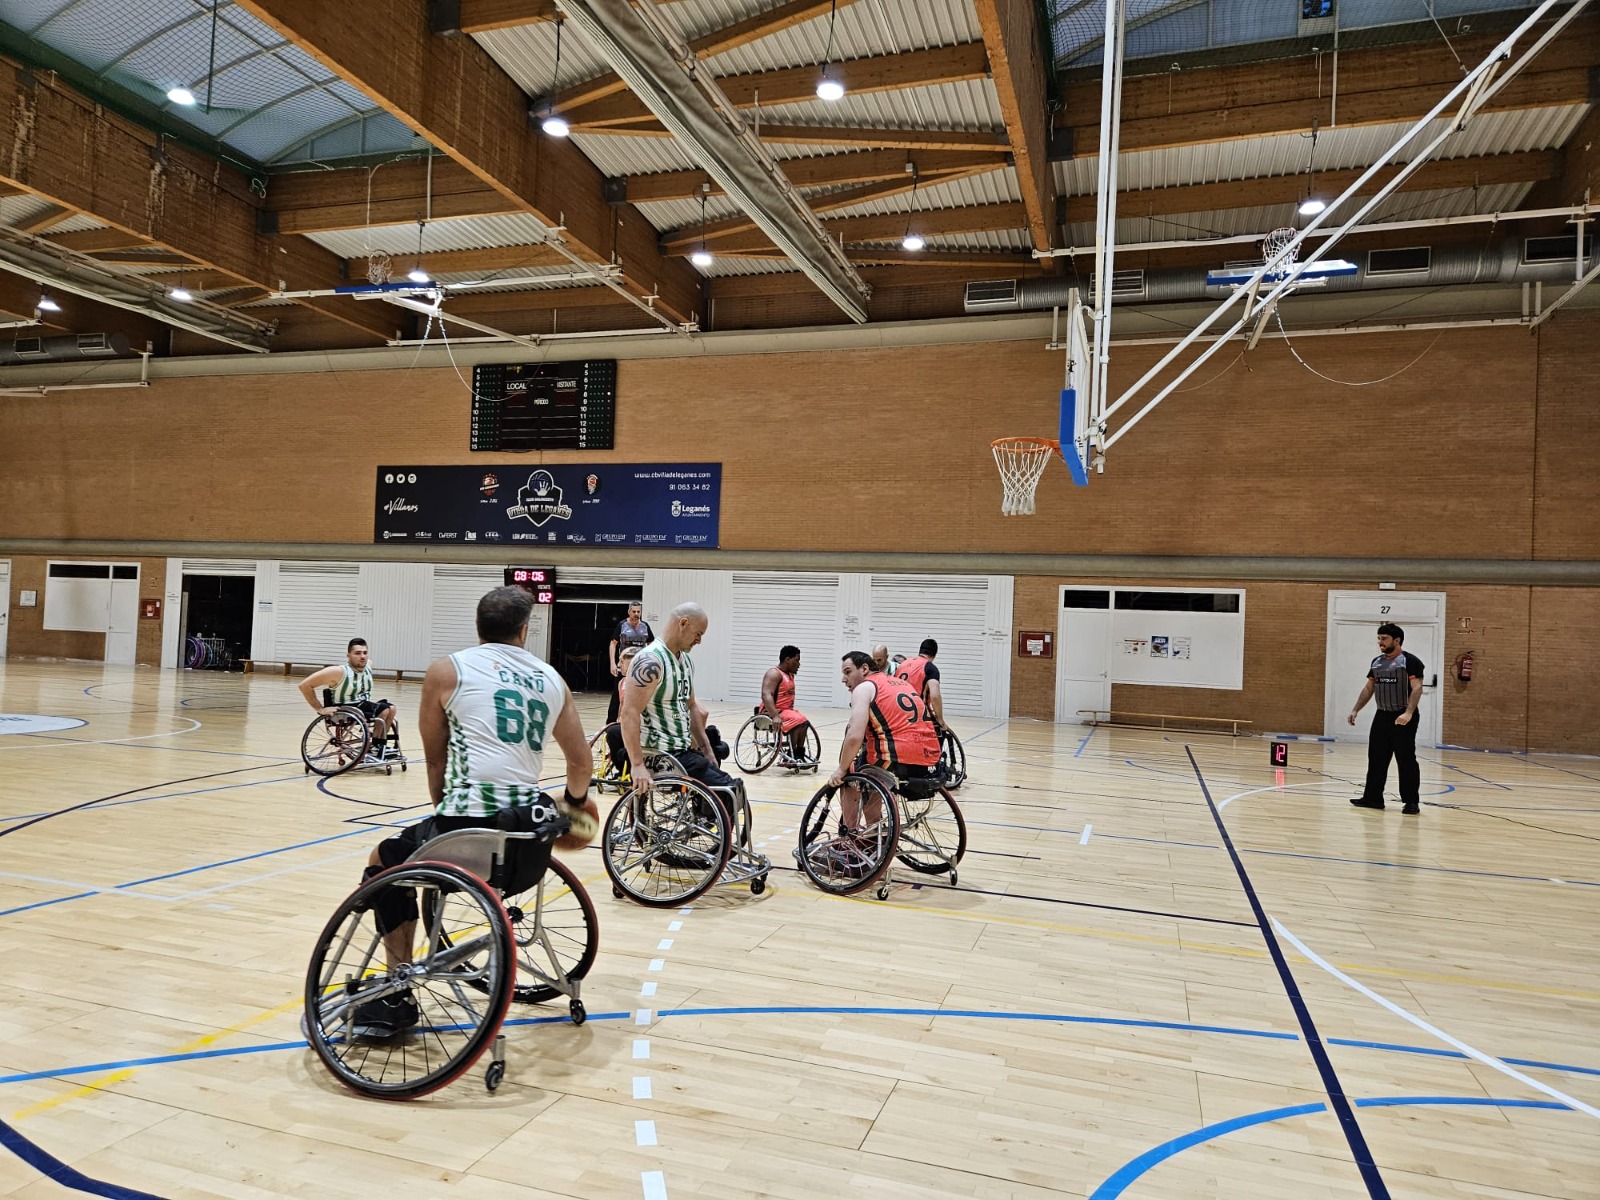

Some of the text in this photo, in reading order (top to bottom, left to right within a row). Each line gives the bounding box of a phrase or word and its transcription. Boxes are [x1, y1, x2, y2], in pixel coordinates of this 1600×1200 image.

[530, 505, 539, 513] DE
[682, 505, 710, 513] Leganés
[538, 593, 552, 603] 02
[1381, 606, 1391, 614] 27
[493, 689, 550, 753] 68
[1276, 744, 1286, 762] 12
